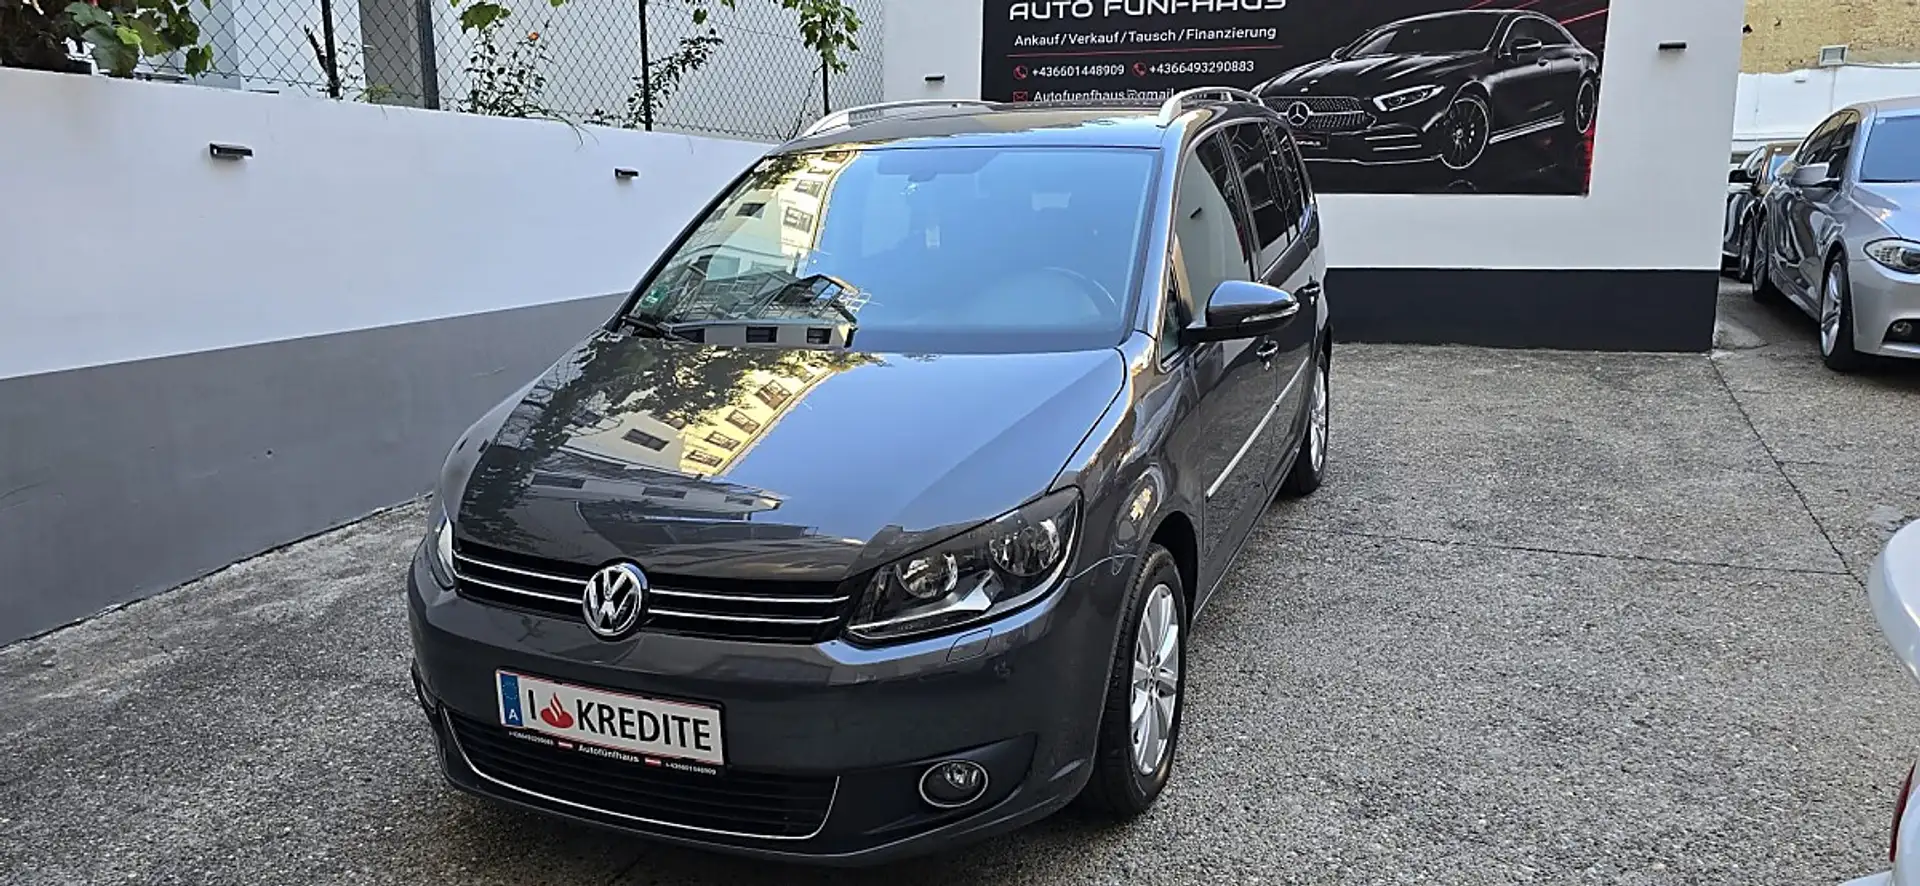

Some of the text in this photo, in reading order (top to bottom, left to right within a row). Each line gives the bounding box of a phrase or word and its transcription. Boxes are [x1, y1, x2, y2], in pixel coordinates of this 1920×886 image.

[1009, 0, 1094, 20] AUTO
[1032, 64, 1125, 77] +436601448909
[508, 708, 519, 721] A
[576, 698, 712, 751] KREDITE
